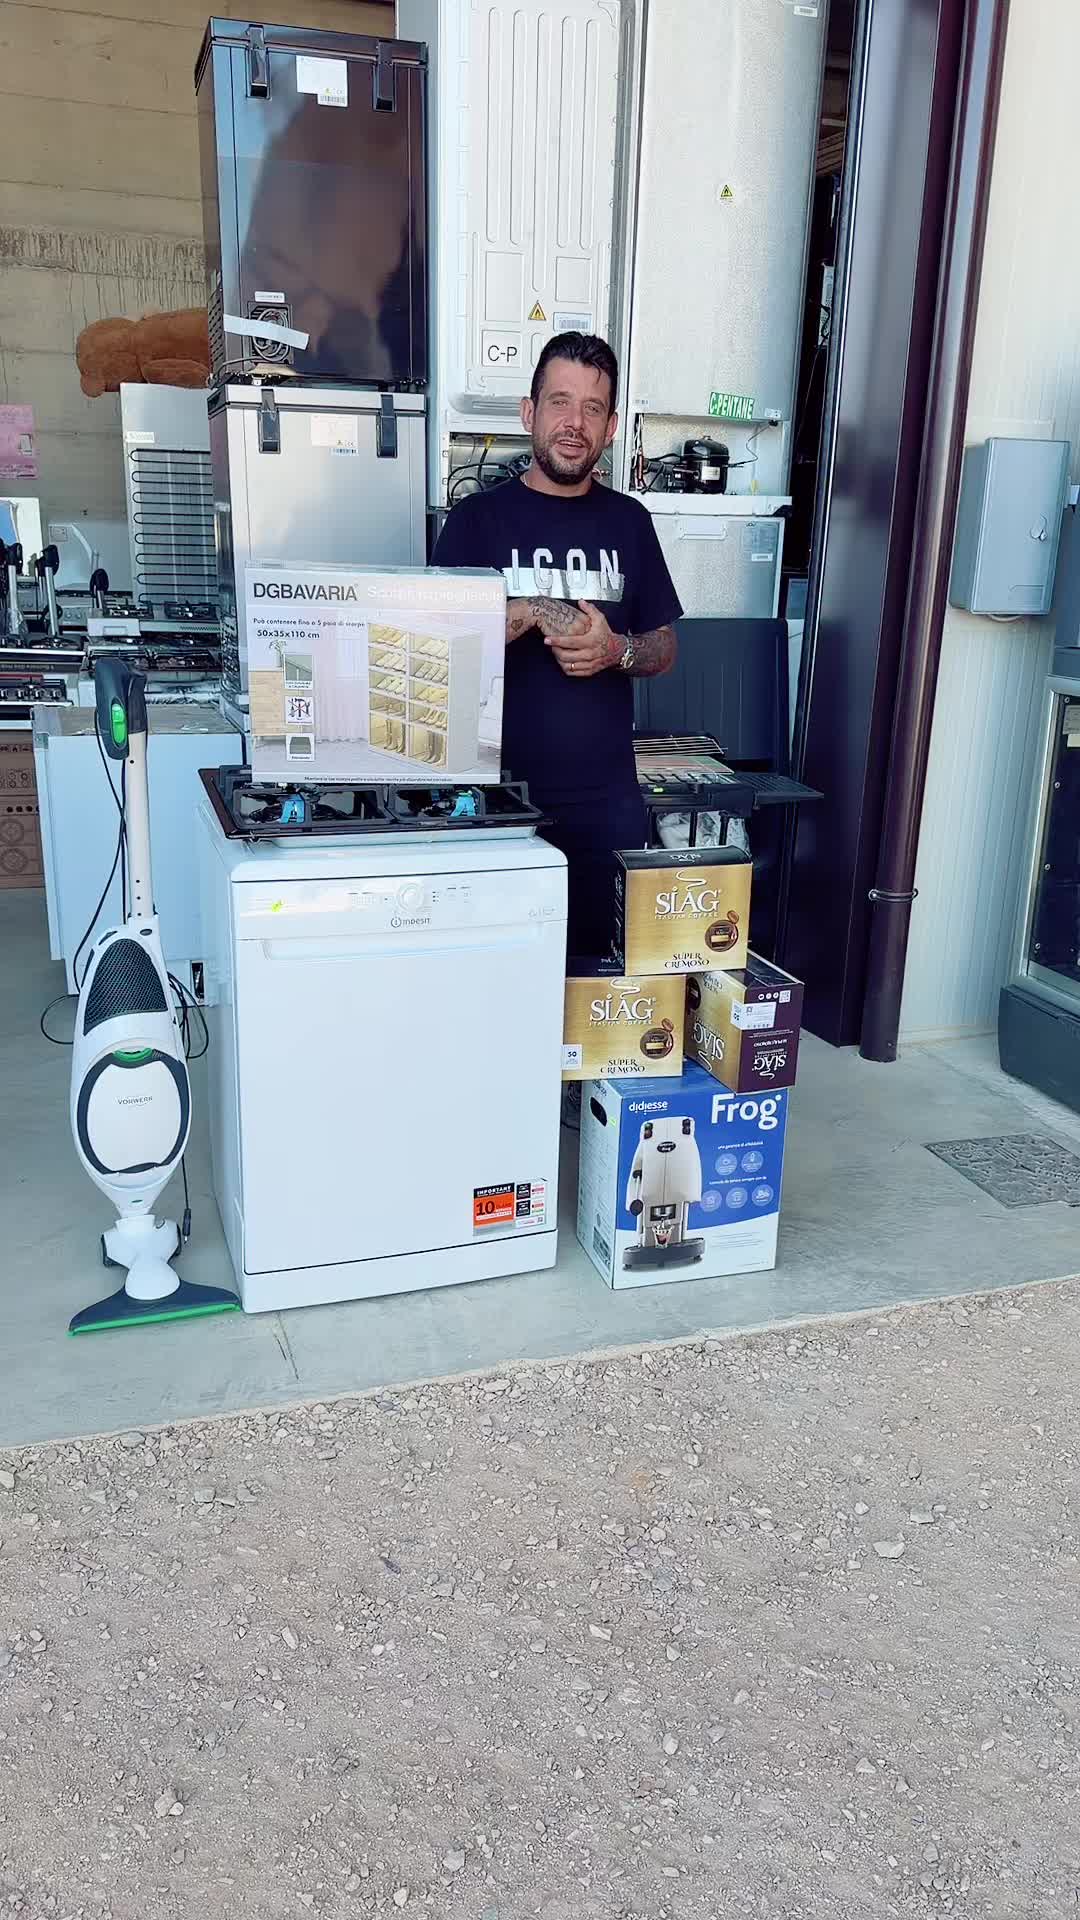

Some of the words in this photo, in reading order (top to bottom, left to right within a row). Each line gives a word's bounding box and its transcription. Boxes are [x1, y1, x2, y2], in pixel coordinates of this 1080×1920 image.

[487, 344, 518, 362] C-P
[710, 392, 754, 420] C-PENTANE
[511, 548, 620, 591] ICON
[253, 582, 358, 601] DGBAVARIA
[257, 629, 306, 638] 50x35x110
[672, 952, 703, 960] SUPER
[664, 959, 710, 969] CREMOSO
[600, 1065, 646, 1074] CREMOSO
[608, 1058, 638, 1067] SUPER
[628, 1101, 668, 1115] didiesse
[711, 1093, 780, 1131] Frog
[476, 1185, 512, 1196] IMPORTANT
[476, 1200, 496, 1217] 10
